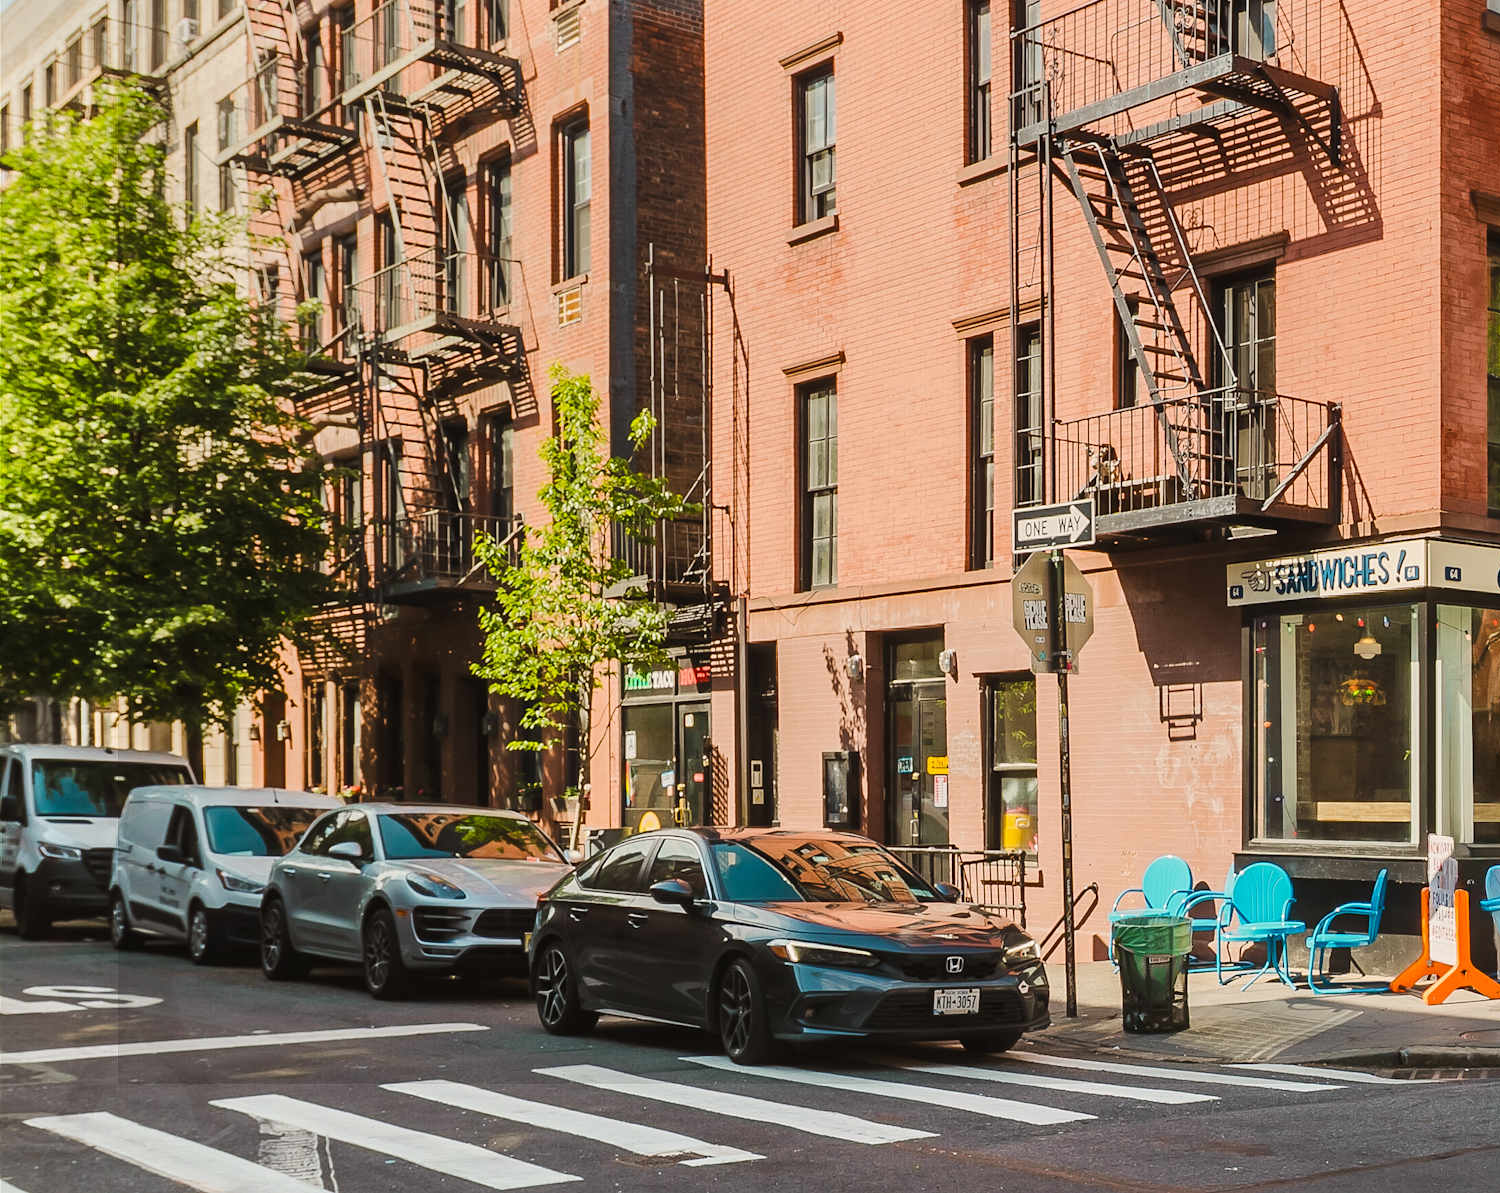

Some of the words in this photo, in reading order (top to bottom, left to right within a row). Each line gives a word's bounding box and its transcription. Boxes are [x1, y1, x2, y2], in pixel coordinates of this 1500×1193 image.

[1025, 520, 1048, 538] ONE
[1058, 515, 1082, 534] WAY
[1274, 551, 1390, 596] SANDWICHES
[652, 670, 676, 689] TACO
